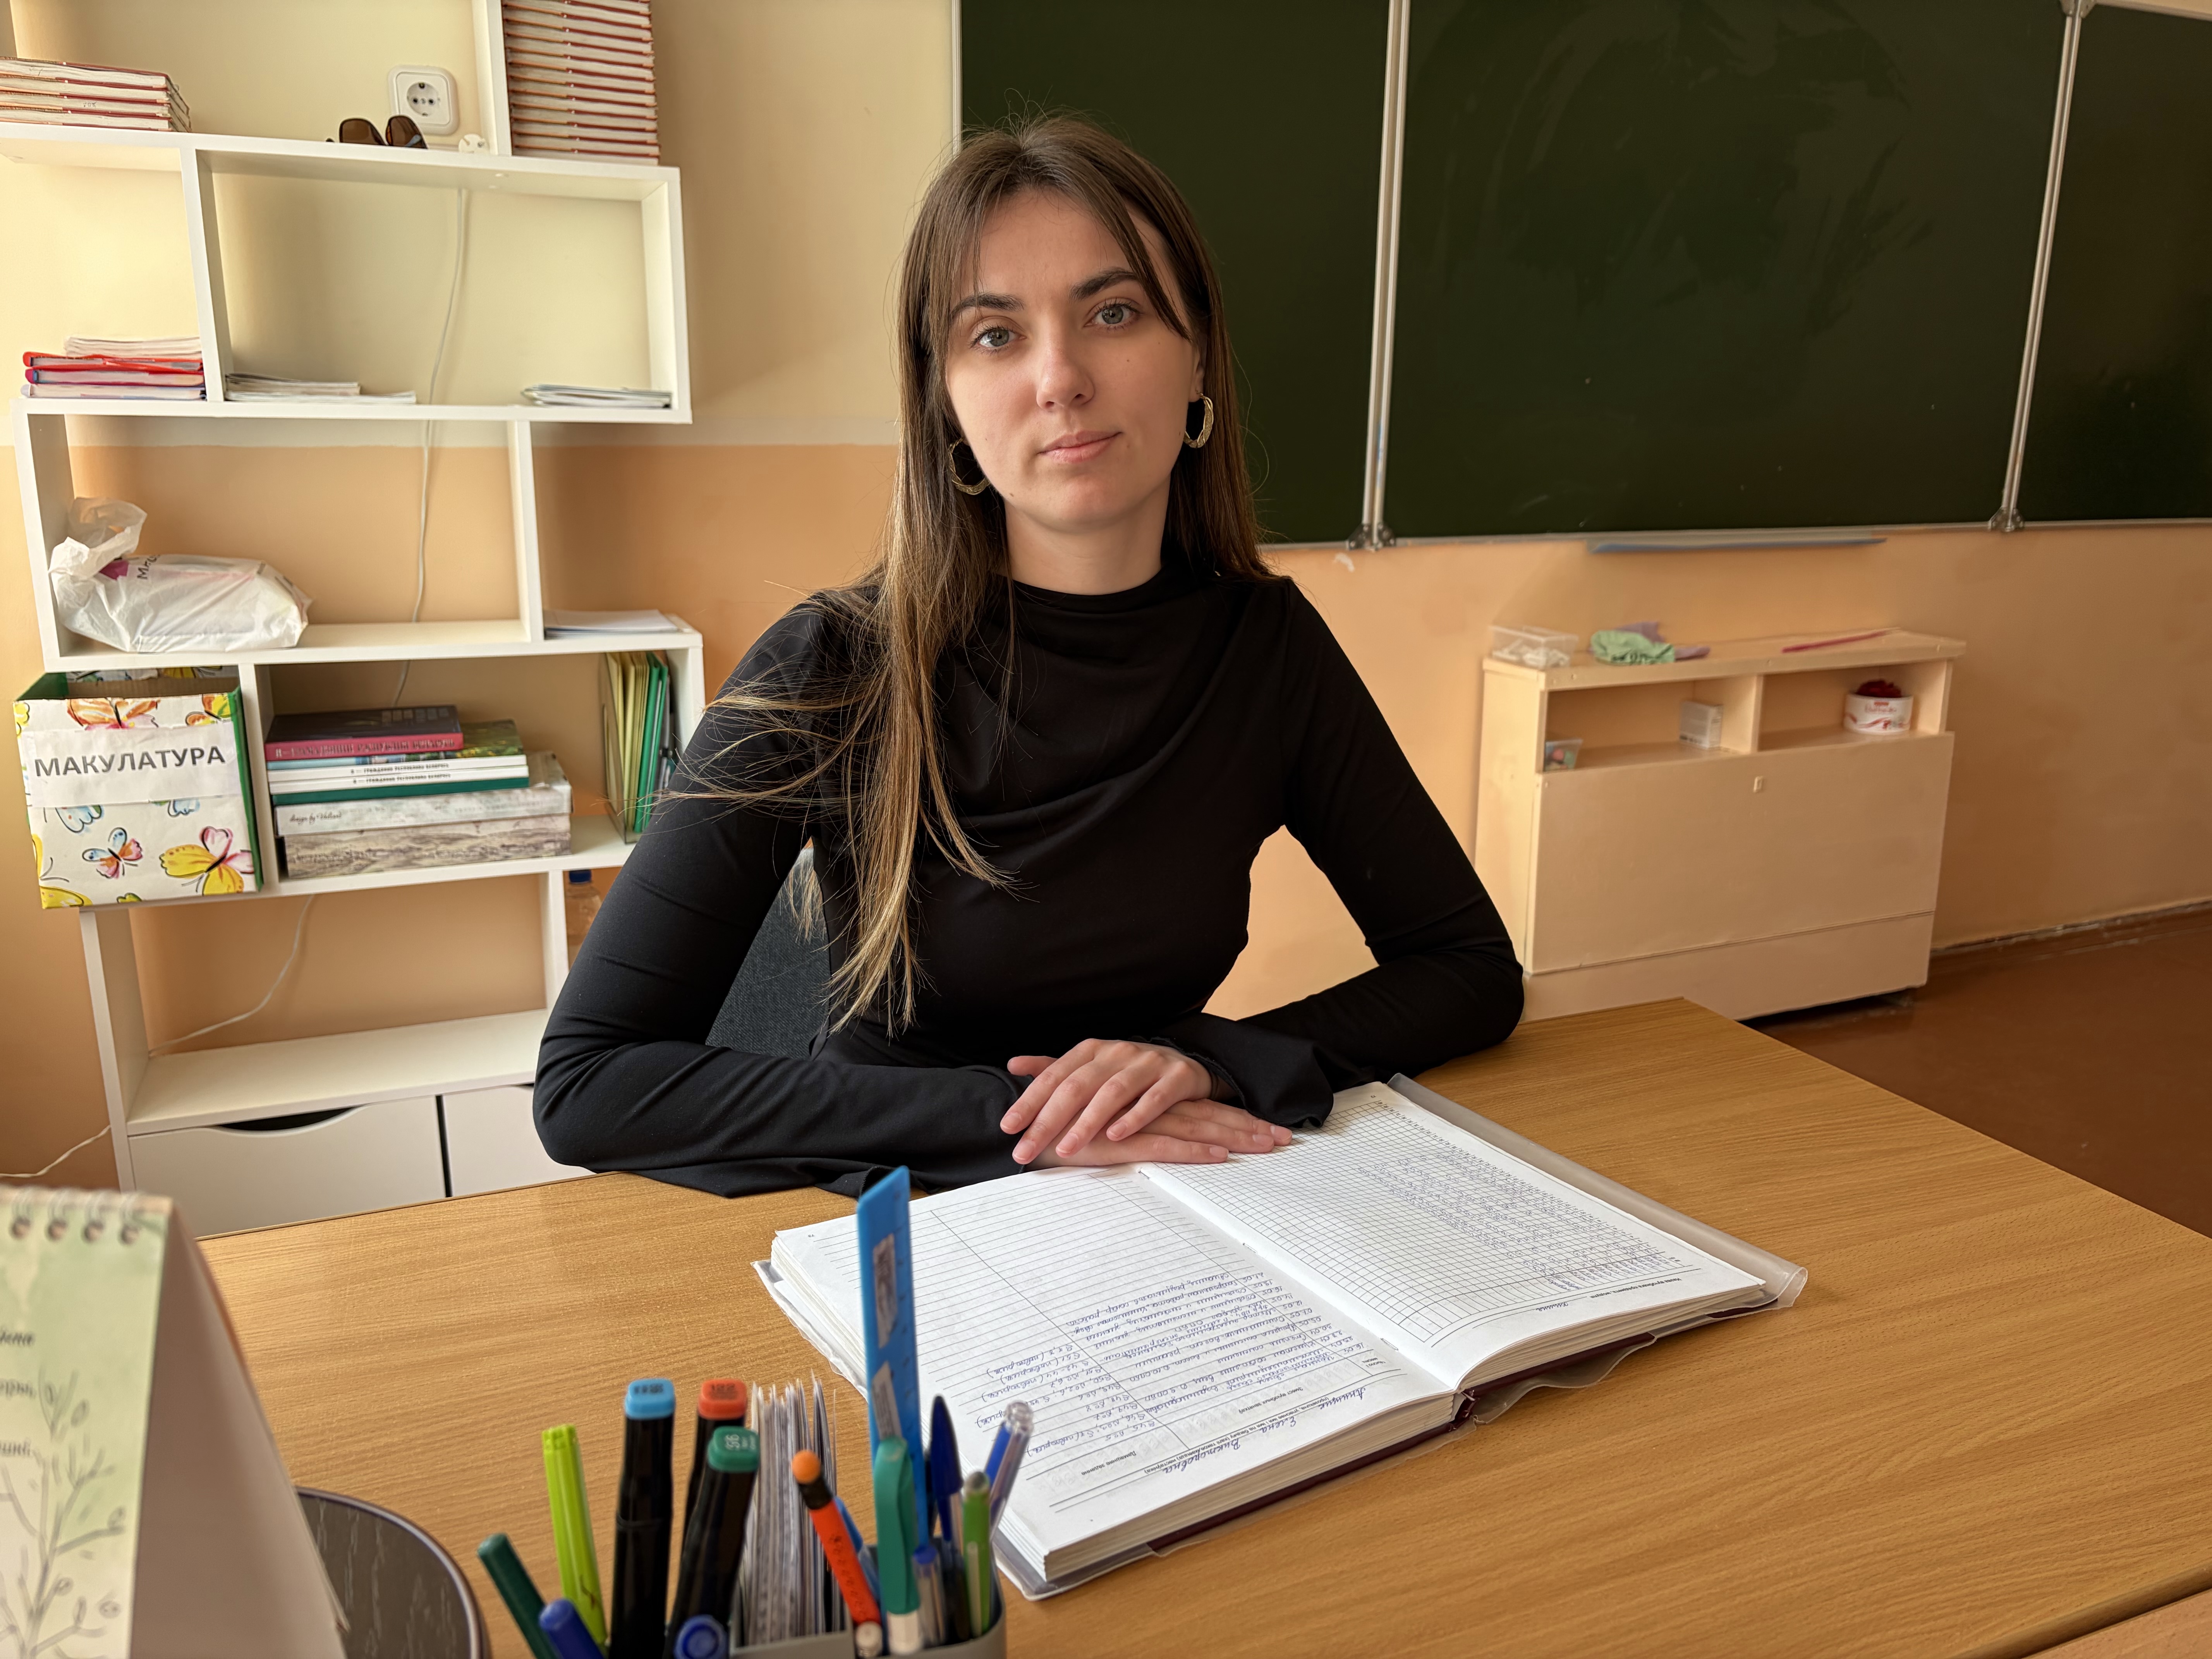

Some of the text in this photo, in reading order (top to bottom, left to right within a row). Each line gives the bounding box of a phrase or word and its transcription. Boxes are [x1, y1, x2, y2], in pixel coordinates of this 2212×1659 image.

[35, 745, 226, 776] МАКУЛАТУРА
[1187, 1273, 1227, 1286] Анализ
[1298, 1317, 1321, 1326] 05.05
[1309, 1325, 1331, 1333] 30.04
[1270, 1334, 1305, 1347] Степень
[1343, 1343, 1365, 1352] 16.04
[1238, 1386, 1304, 1414] Змест вучэбных заняткаў
[1277, 1408, 1300, 1419] уласнае
[1164, 1388, 1369, 1473] Анищик Елена Викторовна
[1230, 1429, 1249, 1438] бацьку
[1216, 1436, 1230, 1444] (калі
[1081, 1450, 1137, 1475] Дамашняе заданне
[1143, 1458, 1176, 1474] настаўніка)
